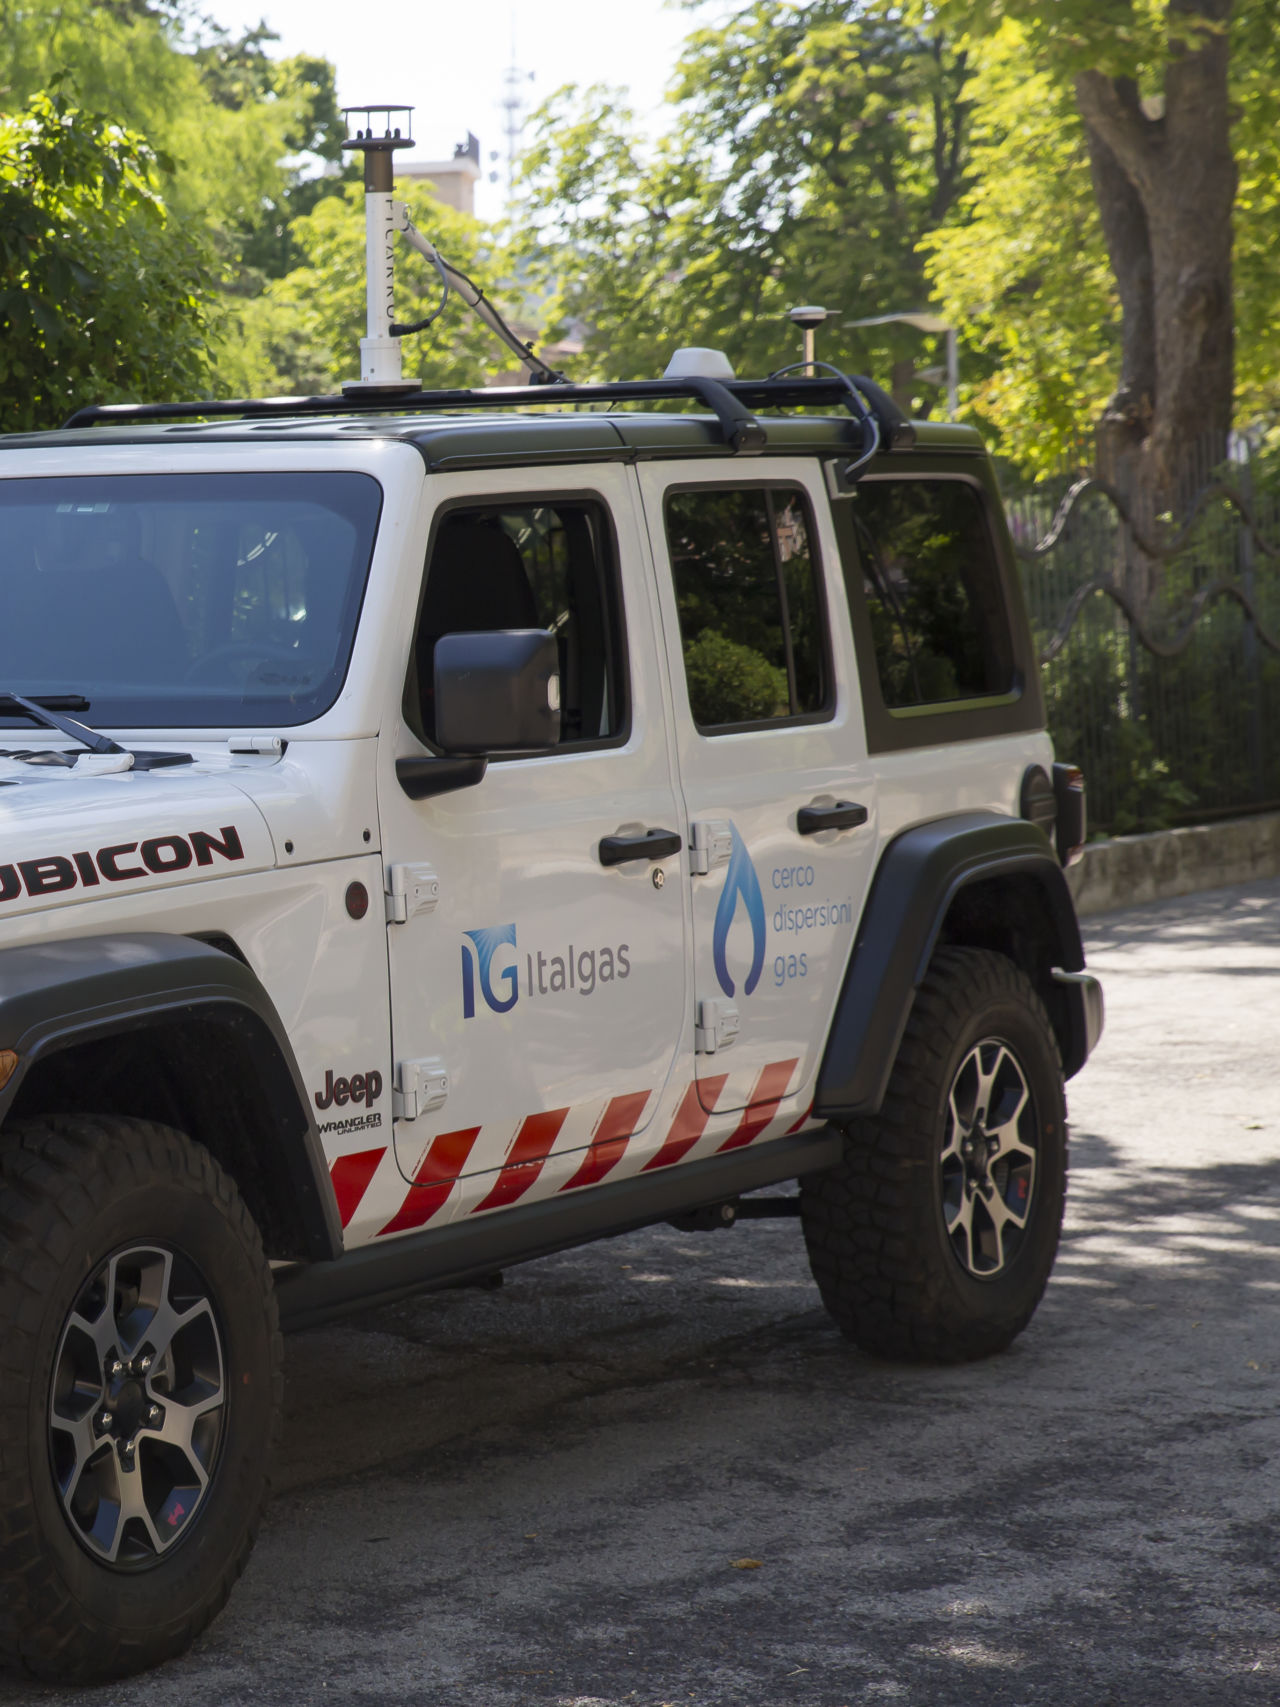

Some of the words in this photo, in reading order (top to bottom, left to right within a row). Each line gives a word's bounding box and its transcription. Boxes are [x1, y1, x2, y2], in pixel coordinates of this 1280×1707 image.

[772, 864, 814, 889] cerco
[773, 896, 852, 935] dispersioni
[527, 943, 631, 996] Italgas
[774, 951, 808, 986] gas
[314, 1069, 383, 1110] Jeep
[317, 1113, 382, 1134] WRANGLER
[337, 1121, 382, 1136] UNLIMITED
